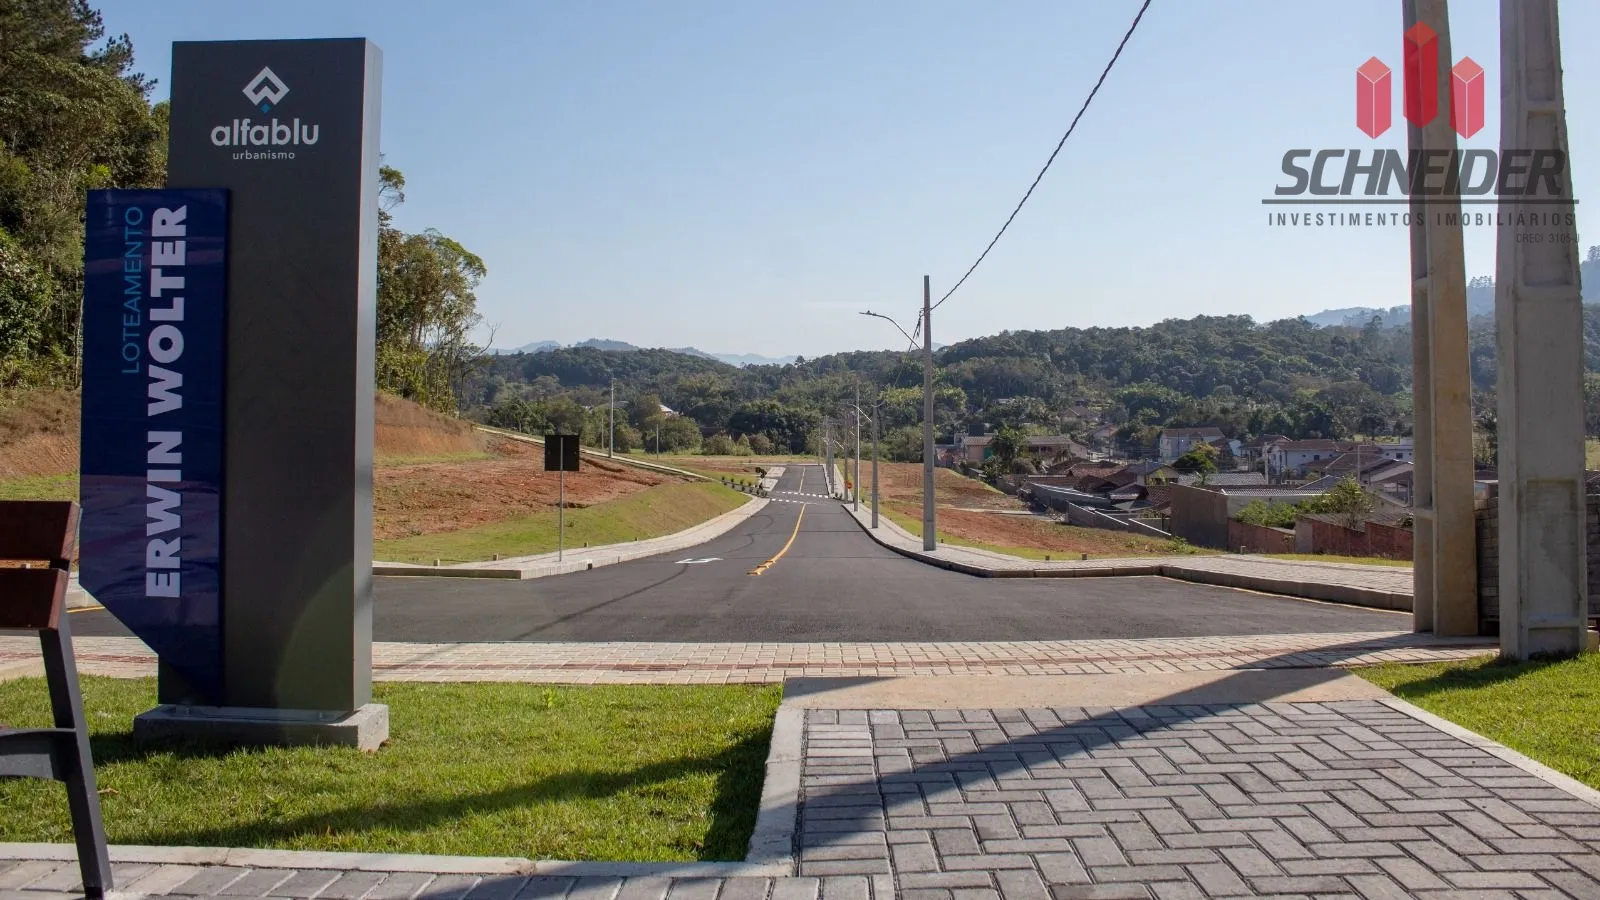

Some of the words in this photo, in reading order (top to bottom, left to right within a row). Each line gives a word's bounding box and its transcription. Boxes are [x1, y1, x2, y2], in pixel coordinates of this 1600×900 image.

[210, 118, 319, 146] alfablu
[232, 149, 296, 160] urbanismo
[121, 206, 144, 374] LOTEAMENTO
[147, 204, 187, 417] WOLTER
[145, 430, 183, 598] ERWIN
